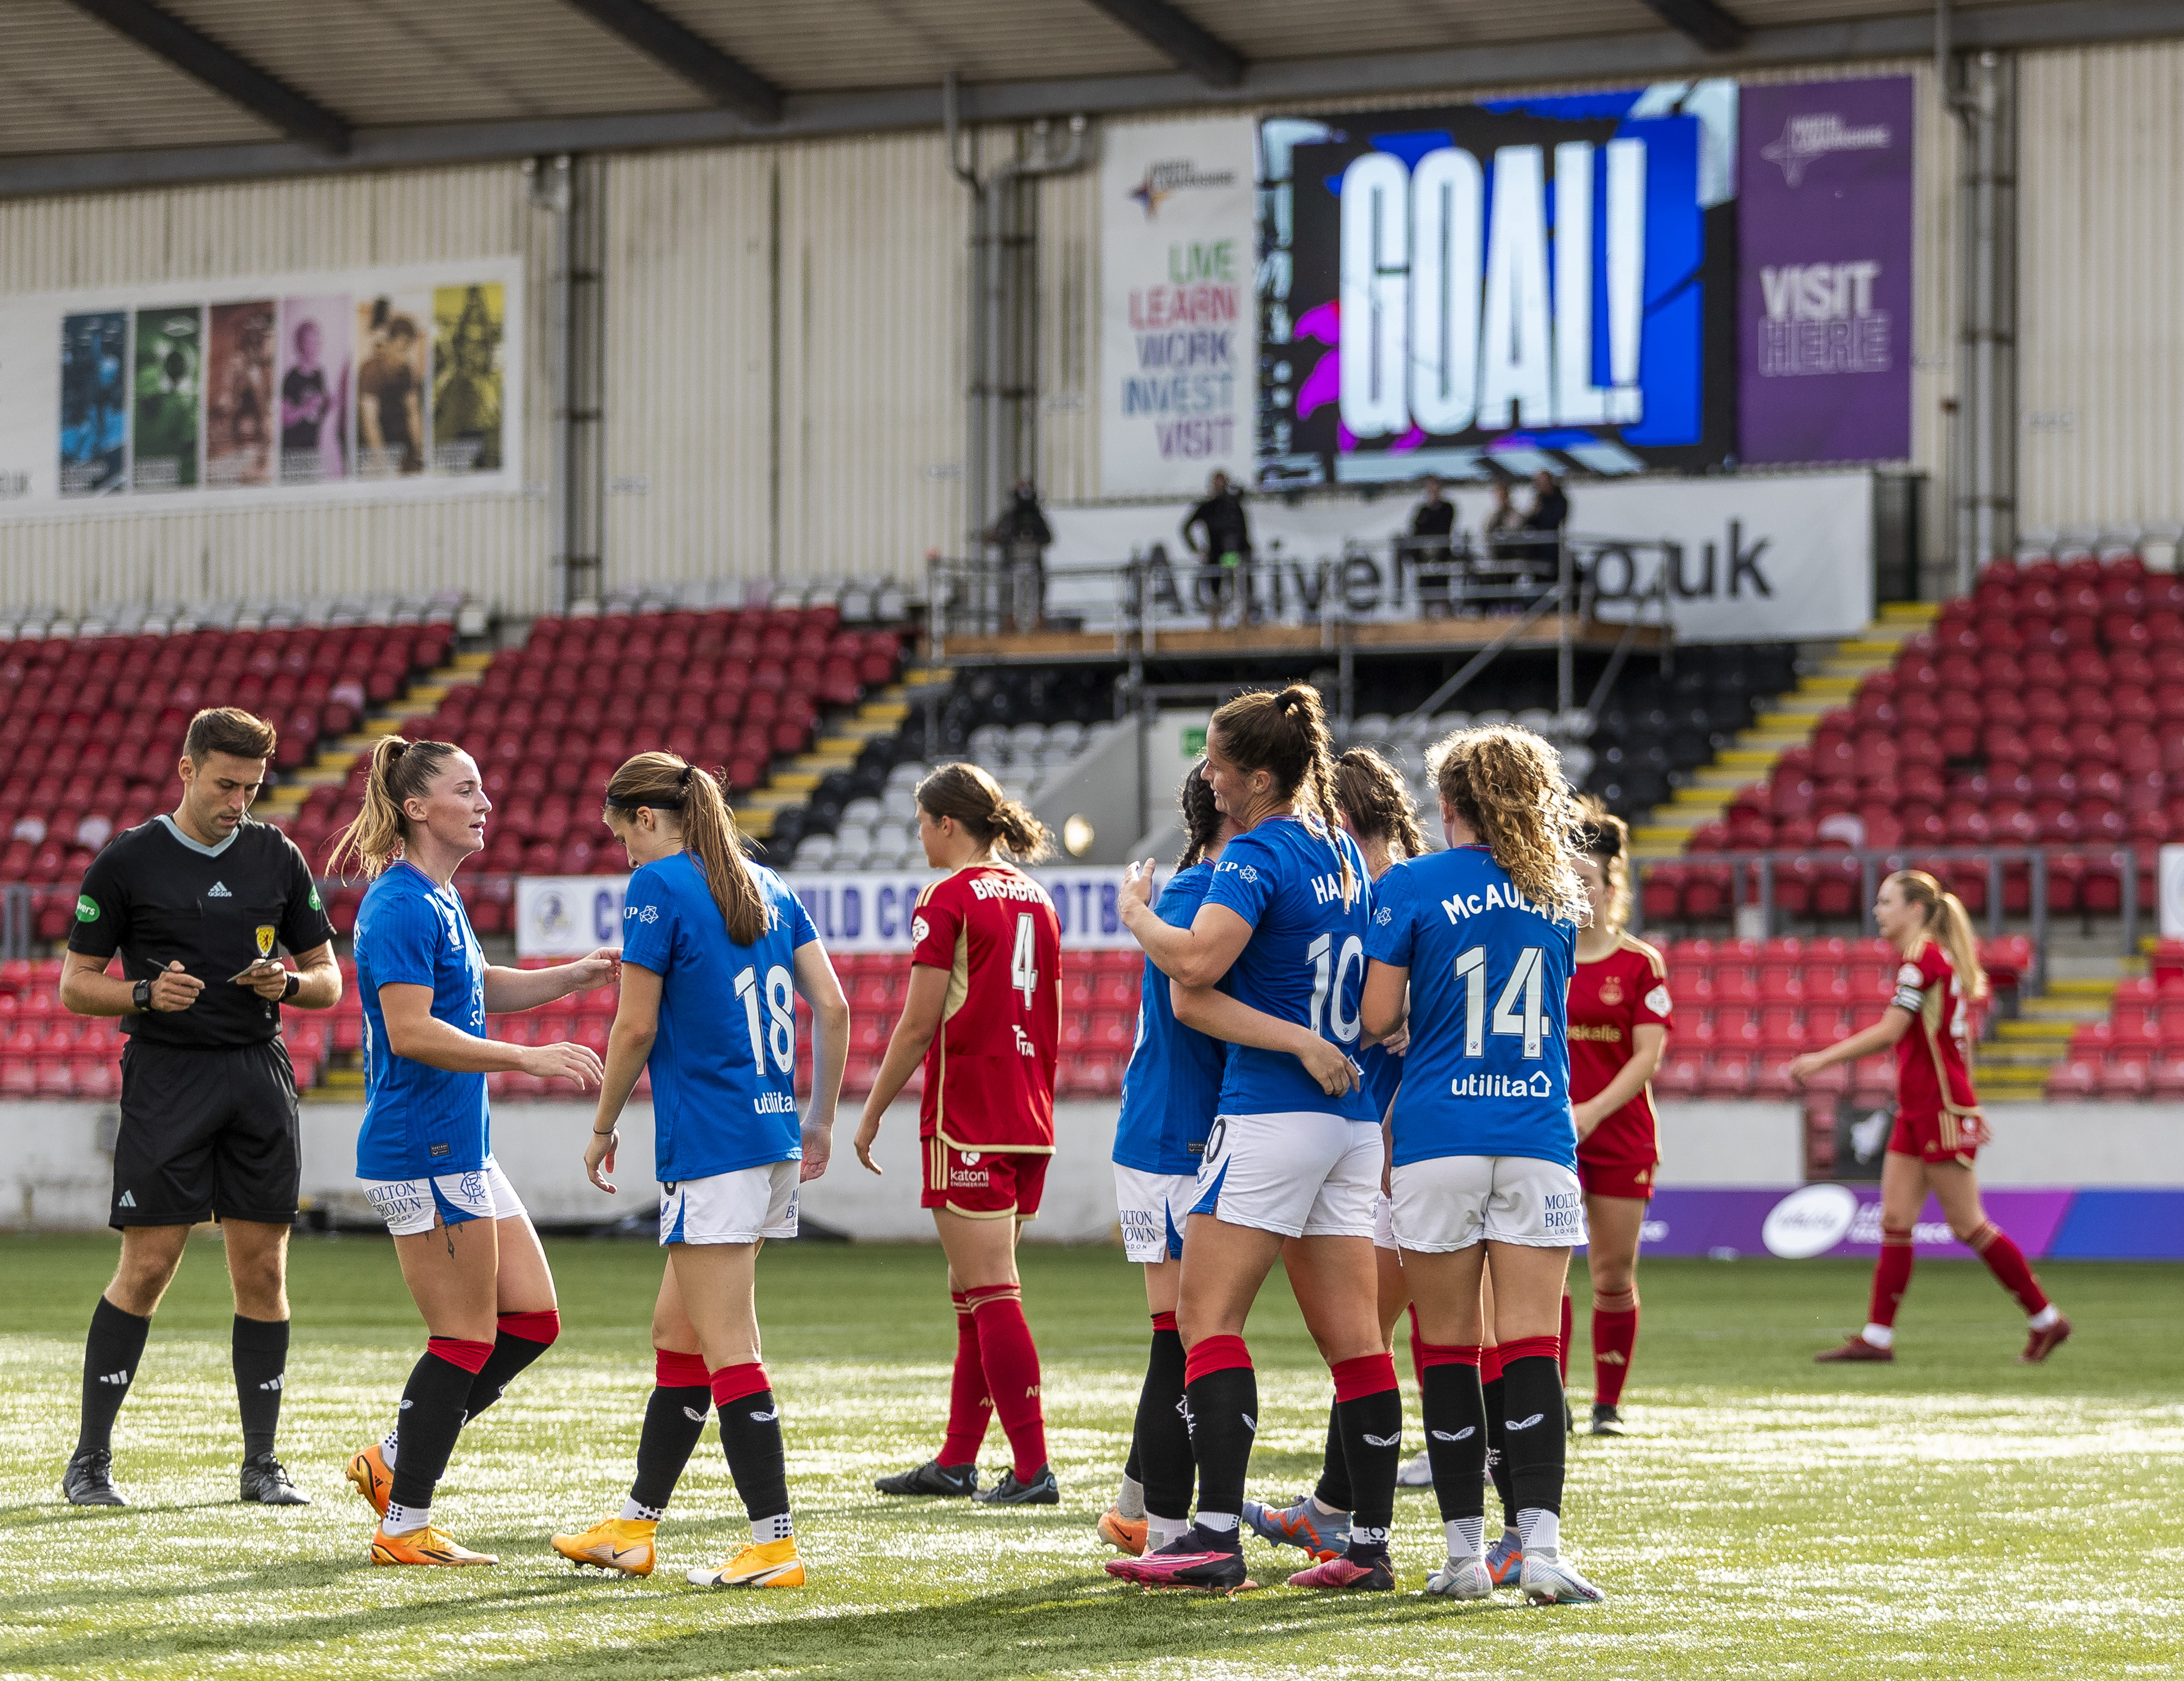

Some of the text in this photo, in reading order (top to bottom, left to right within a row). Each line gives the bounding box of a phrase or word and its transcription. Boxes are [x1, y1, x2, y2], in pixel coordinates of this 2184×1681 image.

[1168, 239, 1237, 285] LIVE
[1128, 285, 1241, 331] LEARN
[1339, 136, 1647, 439] GOAL!
[1761, 259, 1882, 322] VISIT
[1135, 329, 1233, 371] WORK
[1759, 313, 1891, 377] HERE
[1120, 372, 1237, 419] INVEST
[1154, 416, 1236, 460] VISIT
[1011, 912, 1038, 1011] 4
[1305, 931, 1364, 1044] 10
[1454, 945, 1551, 1060] 14
[733, 964, 796, 1077] 18
[753, 1092, 793, 1114] utilita
[1452, 1073, 1527, 1096] utilita
[950, 1166, 989, 1182] katoni
[1119, 1210, 1152, 1226] OLTON
